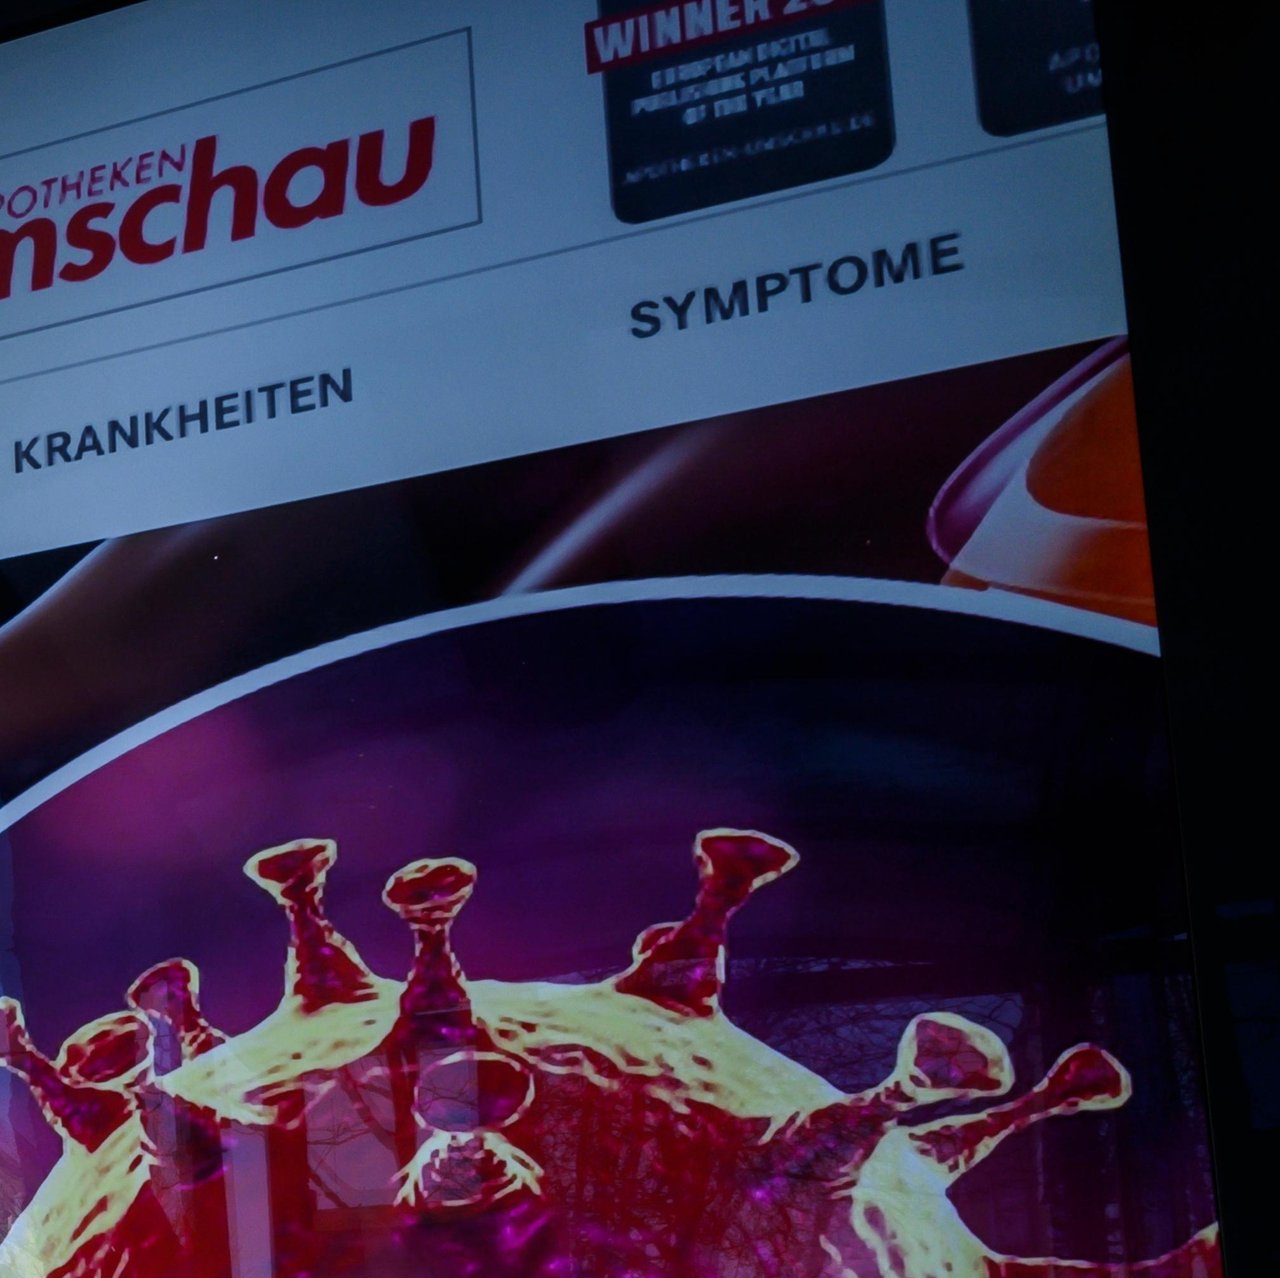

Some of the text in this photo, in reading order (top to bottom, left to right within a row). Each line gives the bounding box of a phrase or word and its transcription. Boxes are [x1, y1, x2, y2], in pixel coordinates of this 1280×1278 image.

[594, 0, 770, 63] WINNER
[630, 233, 965, 339] SYMPTOME
[13, 368, 354, 474] KRANKHEITEN
